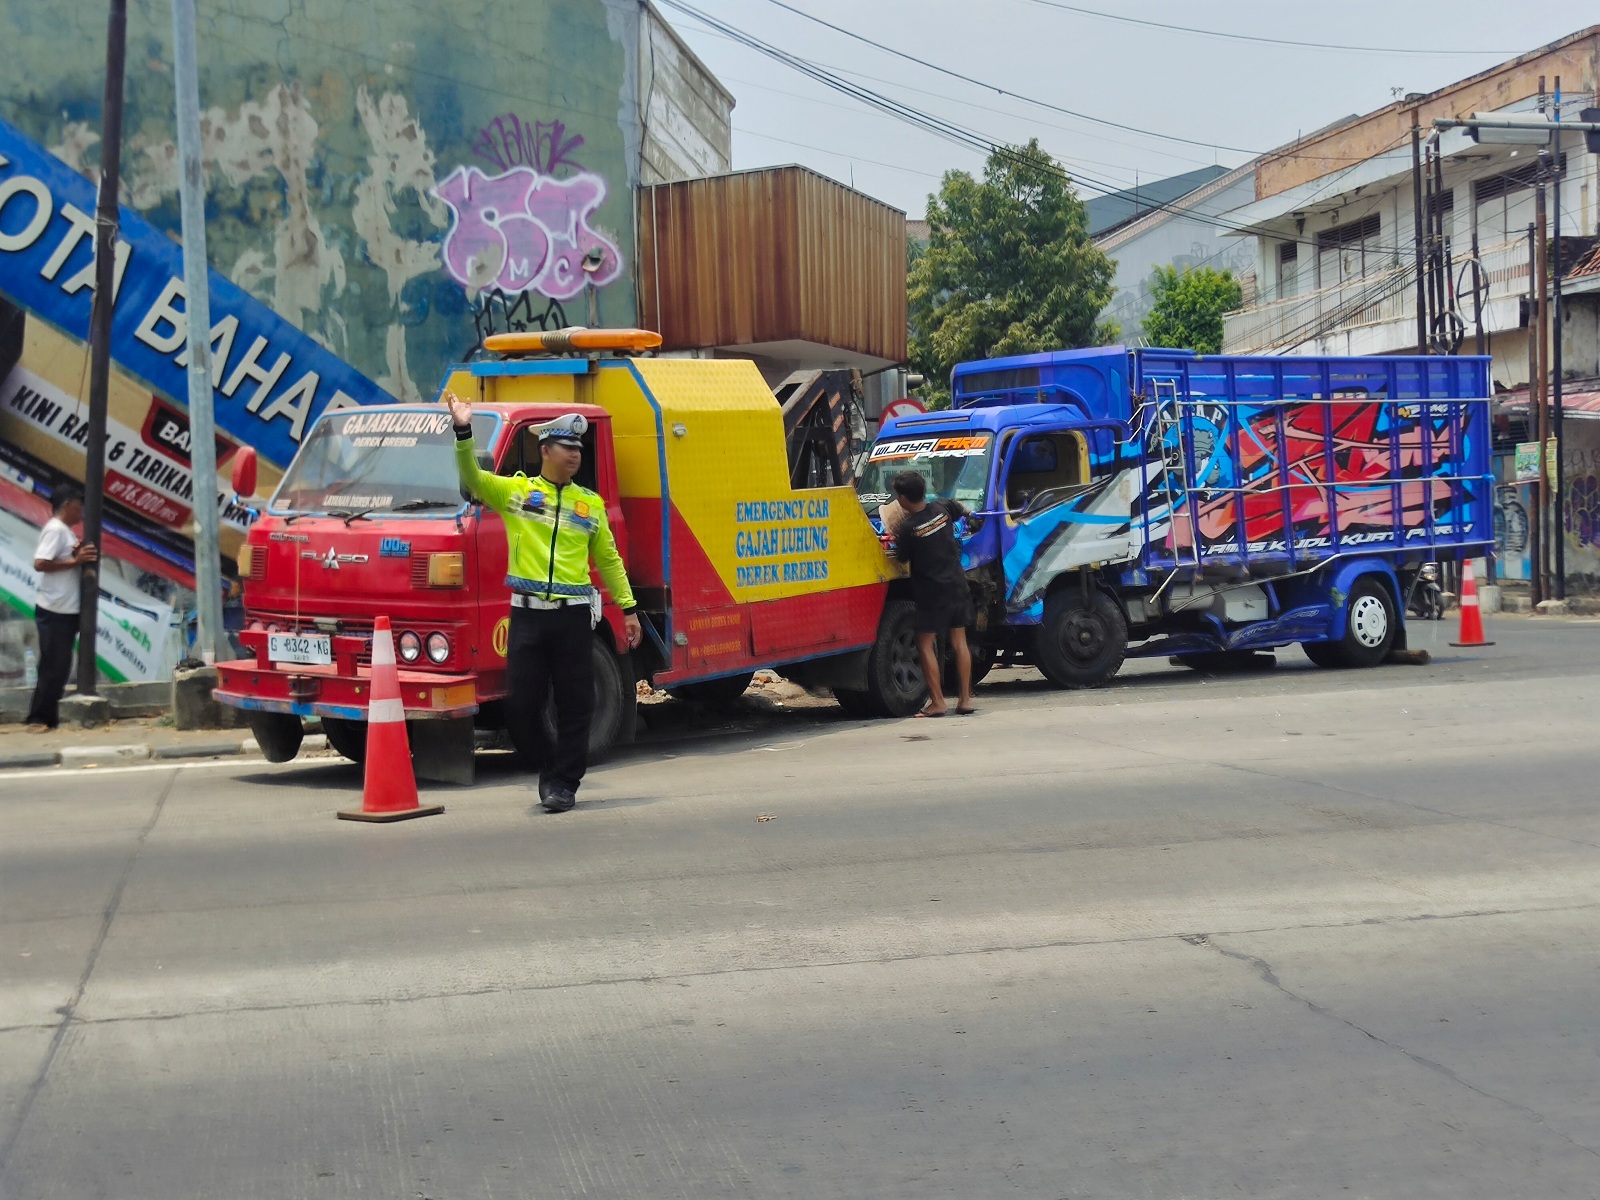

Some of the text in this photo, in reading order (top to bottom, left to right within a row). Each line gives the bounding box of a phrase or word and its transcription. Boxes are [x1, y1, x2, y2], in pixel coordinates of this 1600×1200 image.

[0, 156, 132, 306] OTA
[10, 385, 62, 427] KINI
[342, 412, 453, 435] GAJAHLUHUNG
[353, 436, 382, 447] DEREK
[873, 437, 990, 457] WIJAYA FARM
[736, 498, 829, 522] EMERGENCY CAR
[736, 526, 829, 558] GAJAH LUHUNG
[736, 560, 828, 587] DEREK BREBES
[270, 638, 278, 652] G
